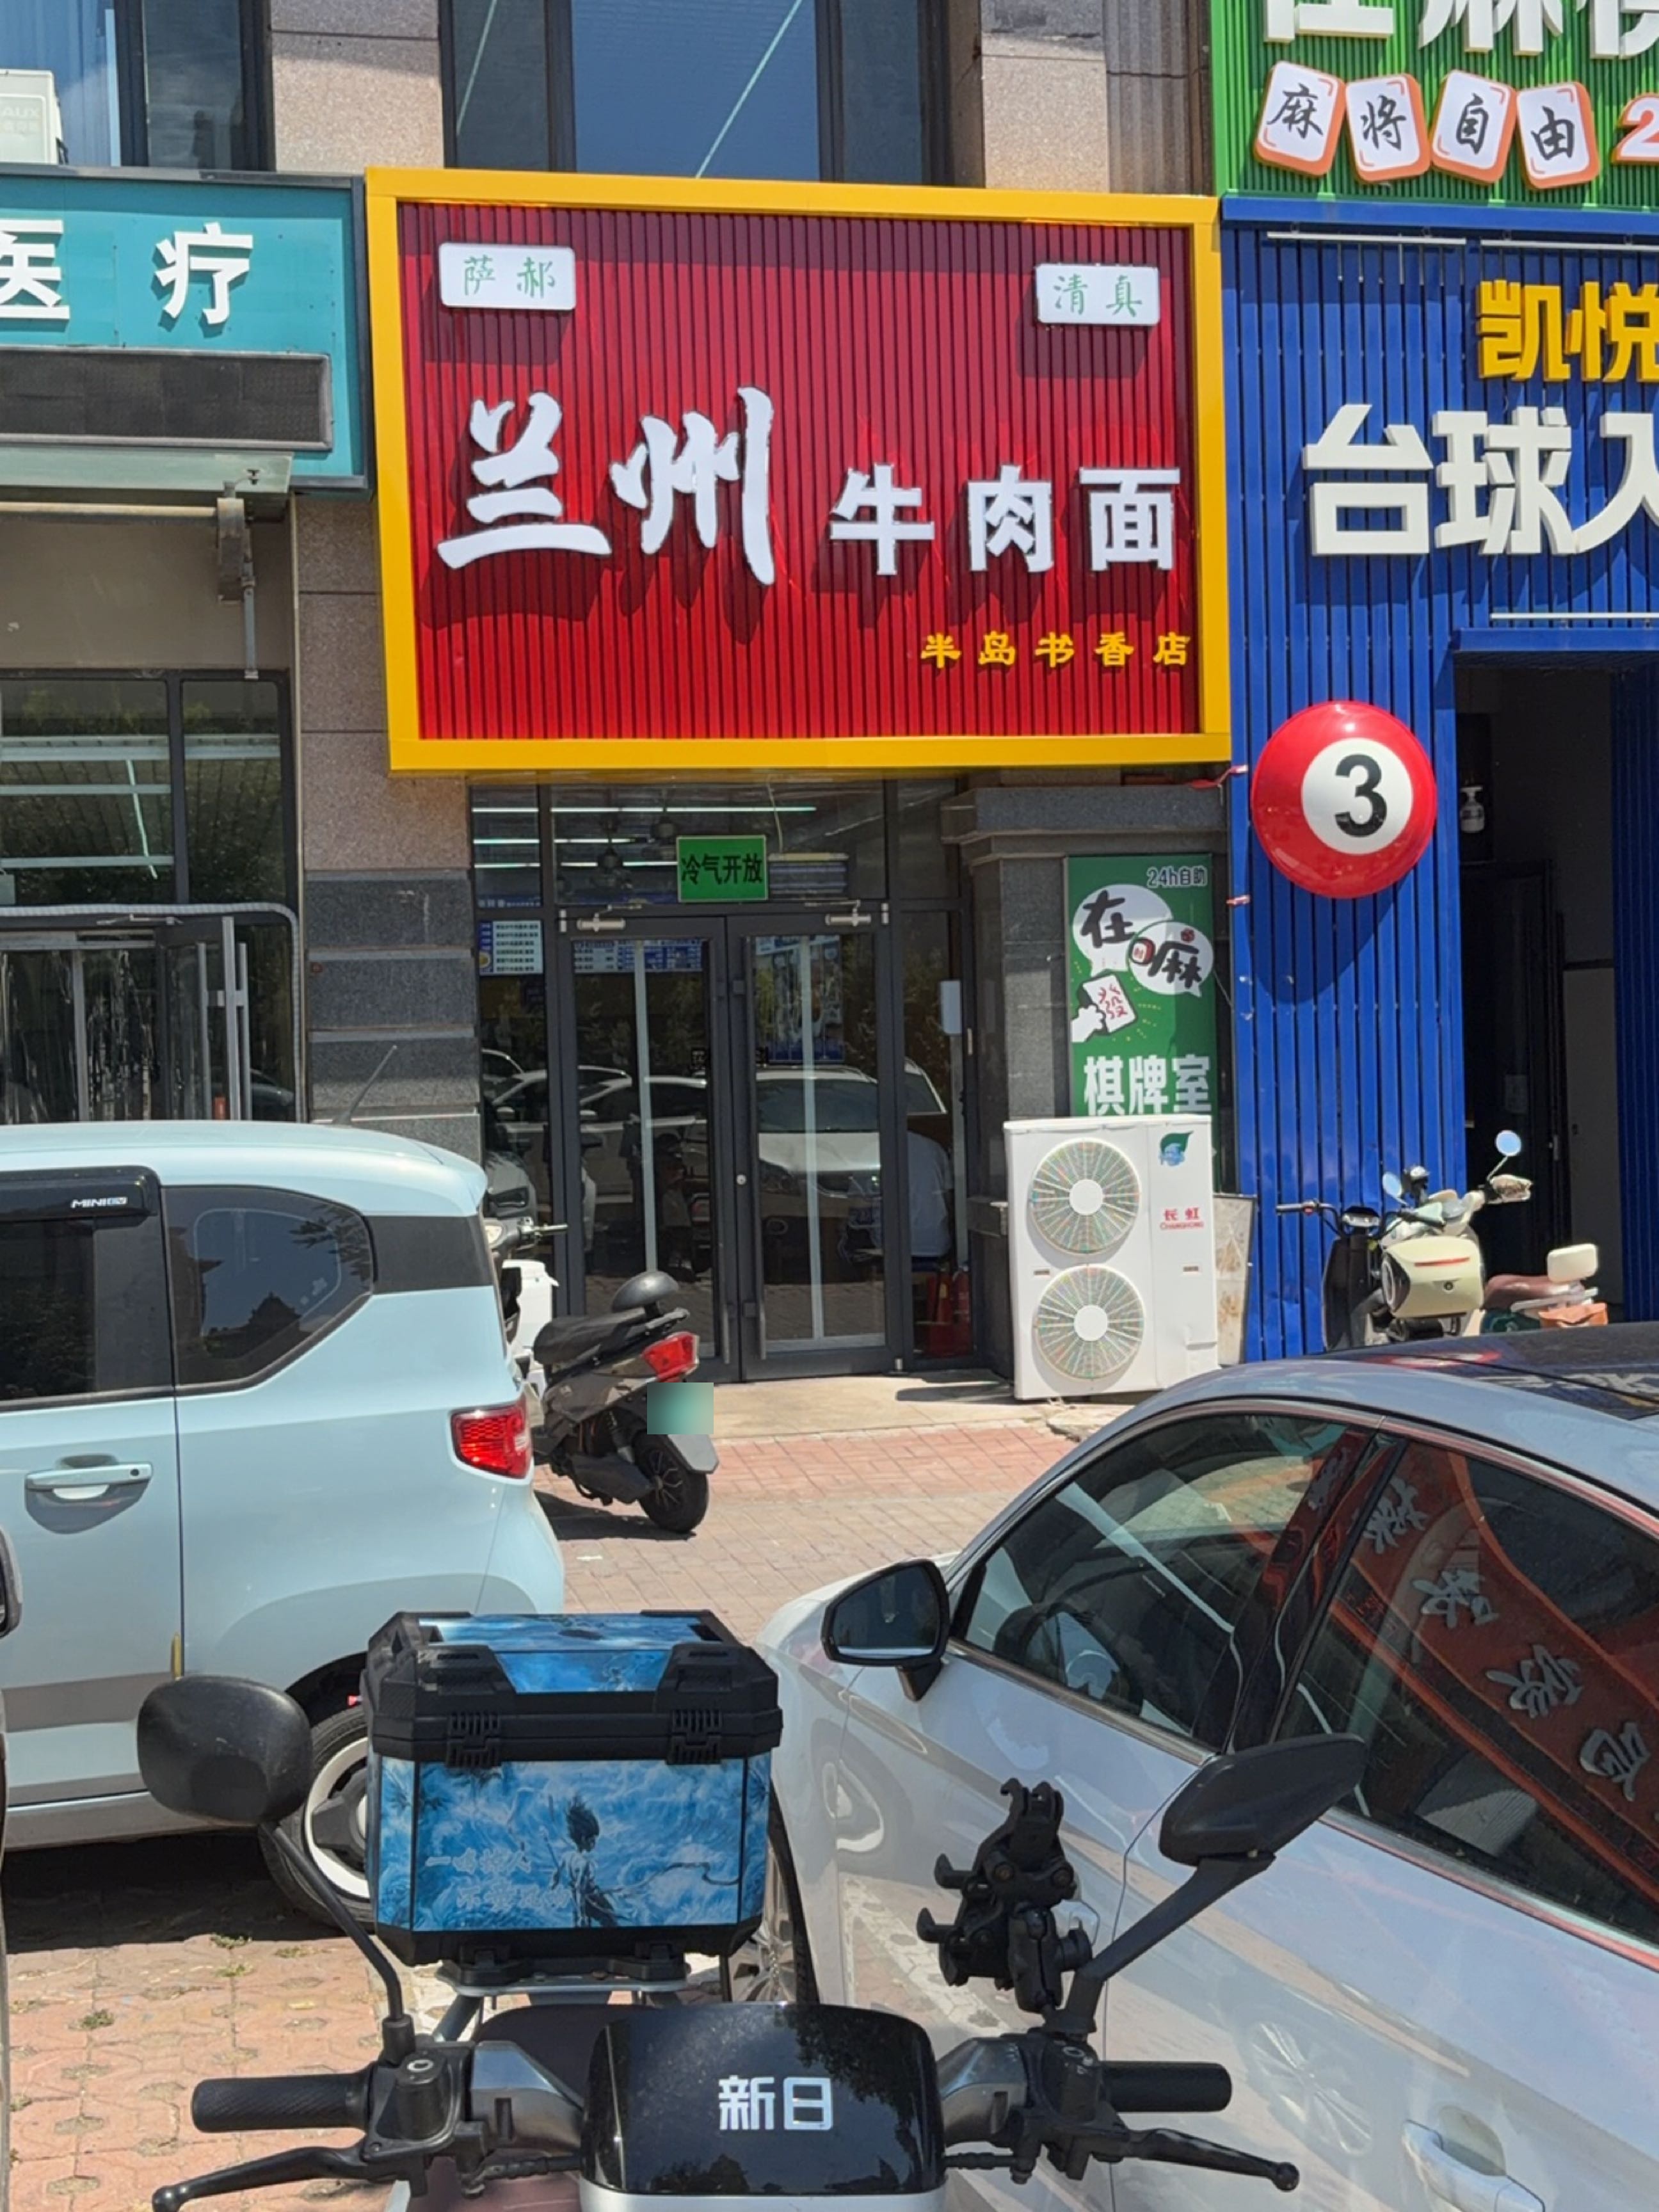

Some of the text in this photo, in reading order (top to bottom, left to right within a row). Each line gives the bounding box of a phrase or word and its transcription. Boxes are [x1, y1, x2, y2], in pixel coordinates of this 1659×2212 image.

[1267, 83, 1578, 163] 麻将自由
[0, 220, 253, 325] 医疗
[463, 254, 556, 298] 萨郝
[1053, 273, 1142, 317] 清真
[1477, 279, 1659, 383] 凯悦
[437, 386, 1181, 586] 兰州牛肉面
[920, 631, 1190, 669] 半岛书香店
[1334, 753, 1388, 838] 3
[680, 853, 763, 885] 冷气开放
[1146, 865, 1208, 888] 24h自助
[1084, 1054, 1212, 1116] 棋牌室
[717, 2075, 833, 2131] 新日
